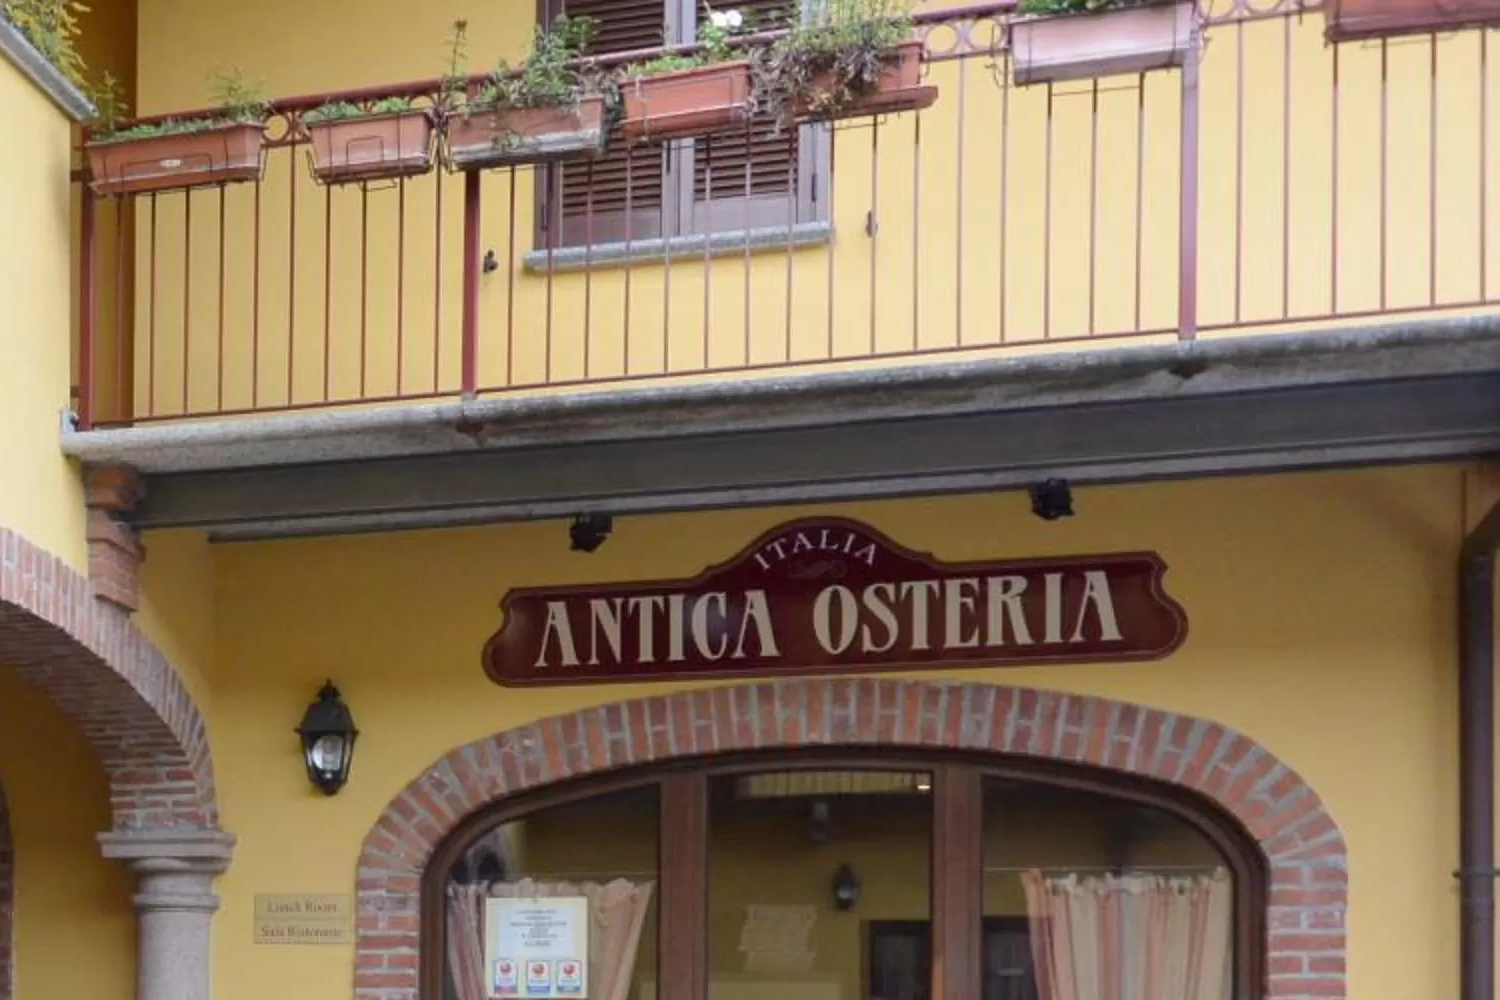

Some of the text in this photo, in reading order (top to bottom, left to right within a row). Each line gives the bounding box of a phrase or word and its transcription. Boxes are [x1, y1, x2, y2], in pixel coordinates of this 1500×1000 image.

[754, 529, 876, 571] ITALIA
[534, 570, 1124, 667] ANTICA OSTERIA
